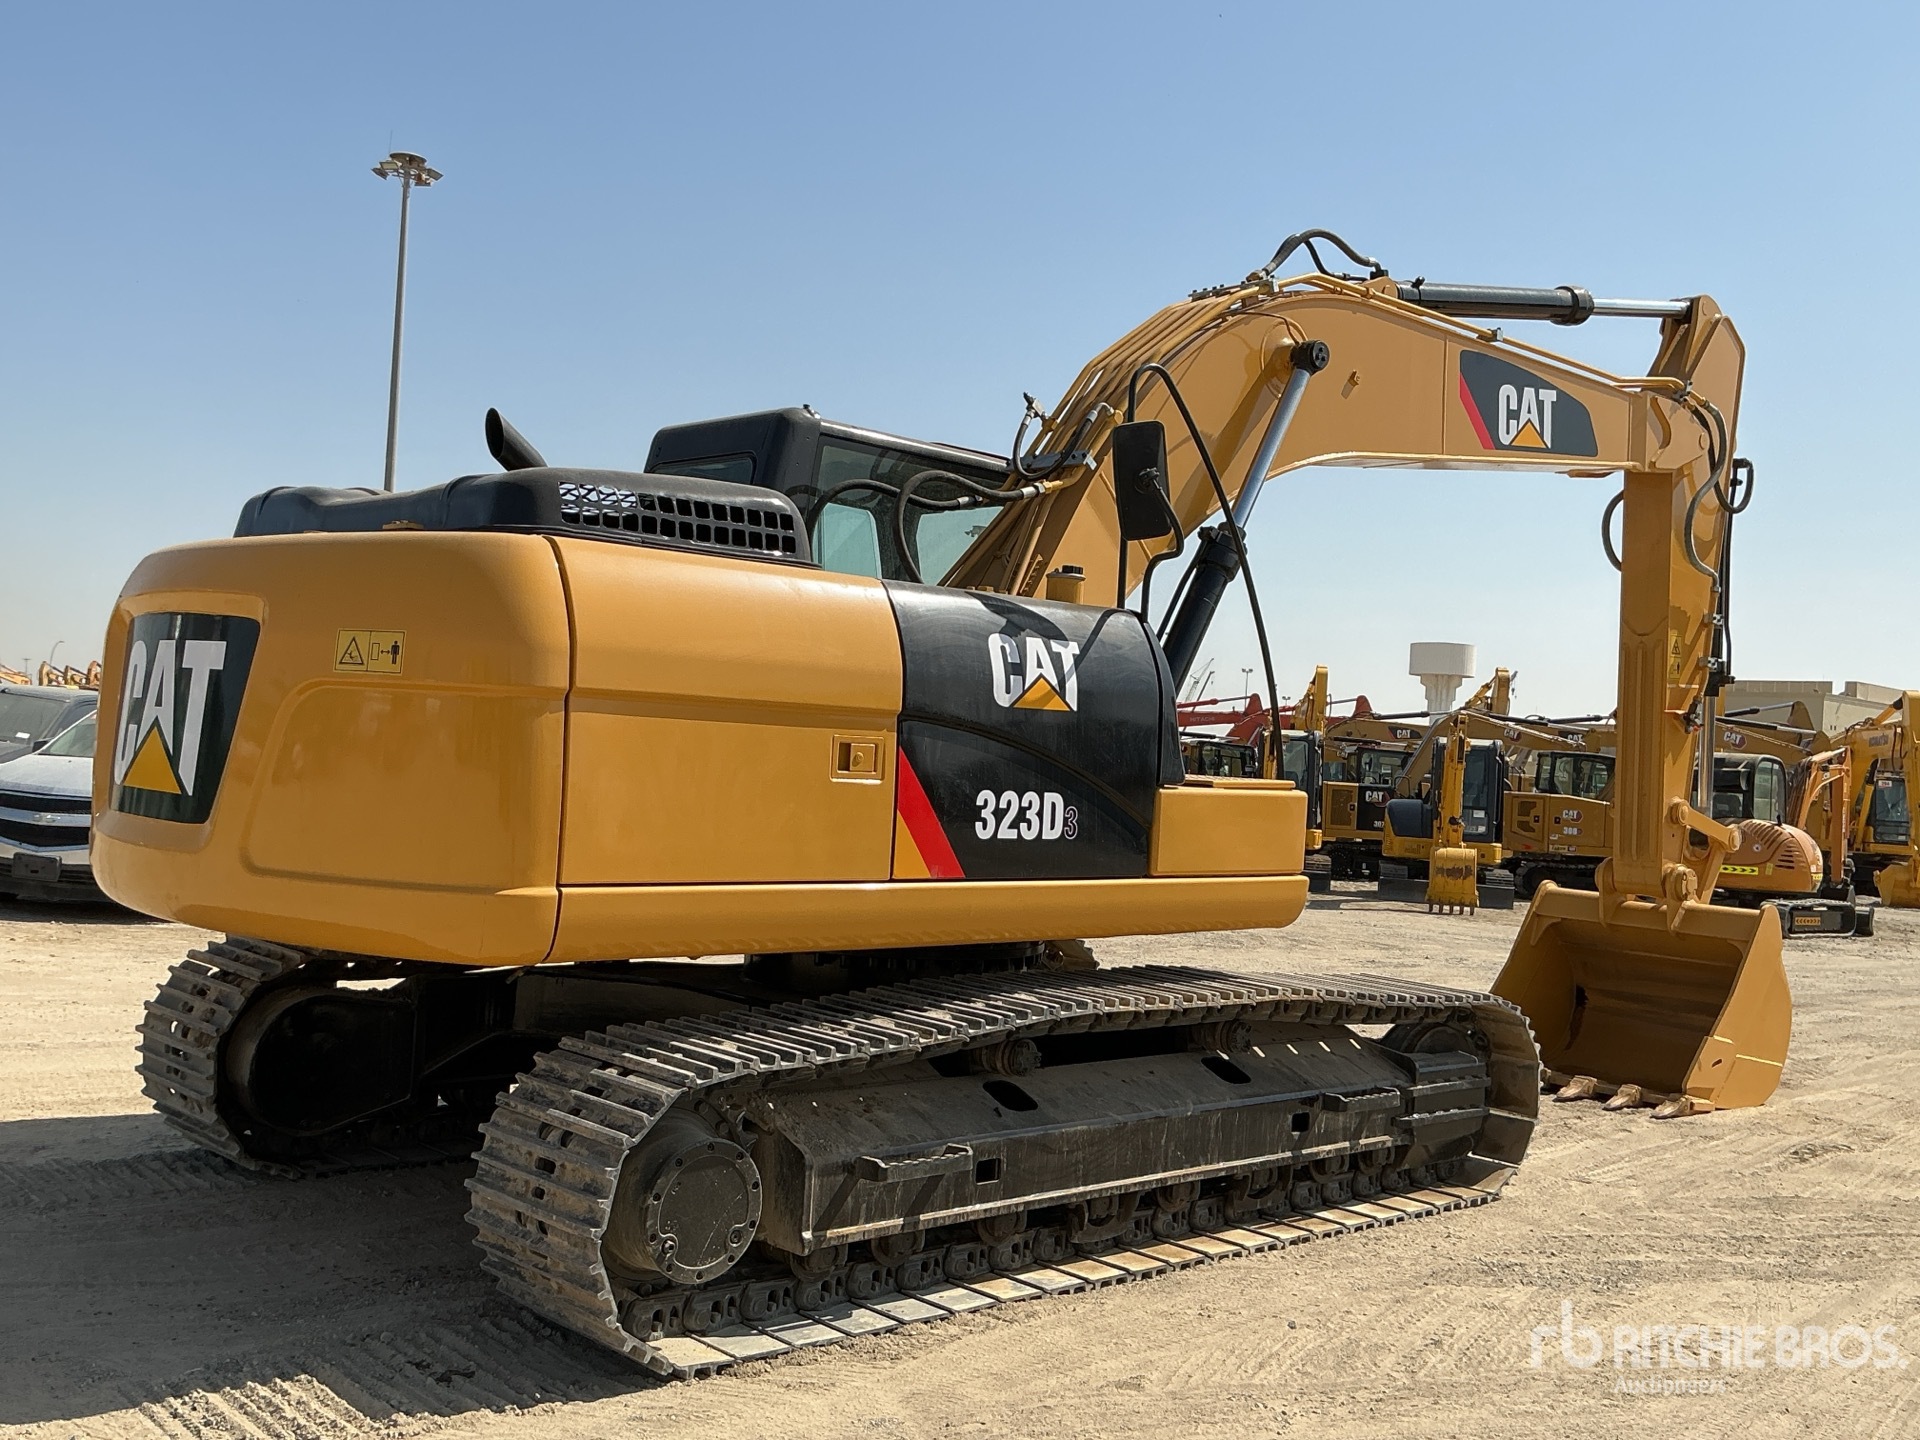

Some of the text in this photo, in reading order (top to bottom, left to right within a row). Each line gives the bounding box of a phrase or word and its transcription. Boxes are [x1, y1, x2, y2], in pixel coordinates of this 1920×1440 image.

[1498, 384, 1556, 449] CAT
[988, 632, 1080, 712] CAT
[114, 639, 227, 796] CAT
[1396, 729, 1411, 739] CAT
[1503, 728, 1519, 739] CAT
[1723, 731, 1741, 745] CAT
[1365, 791, 1384, 803] CAT
[975, 789, 1078, 840] 323D3
[1562, 810, 1578, 820] CAT
